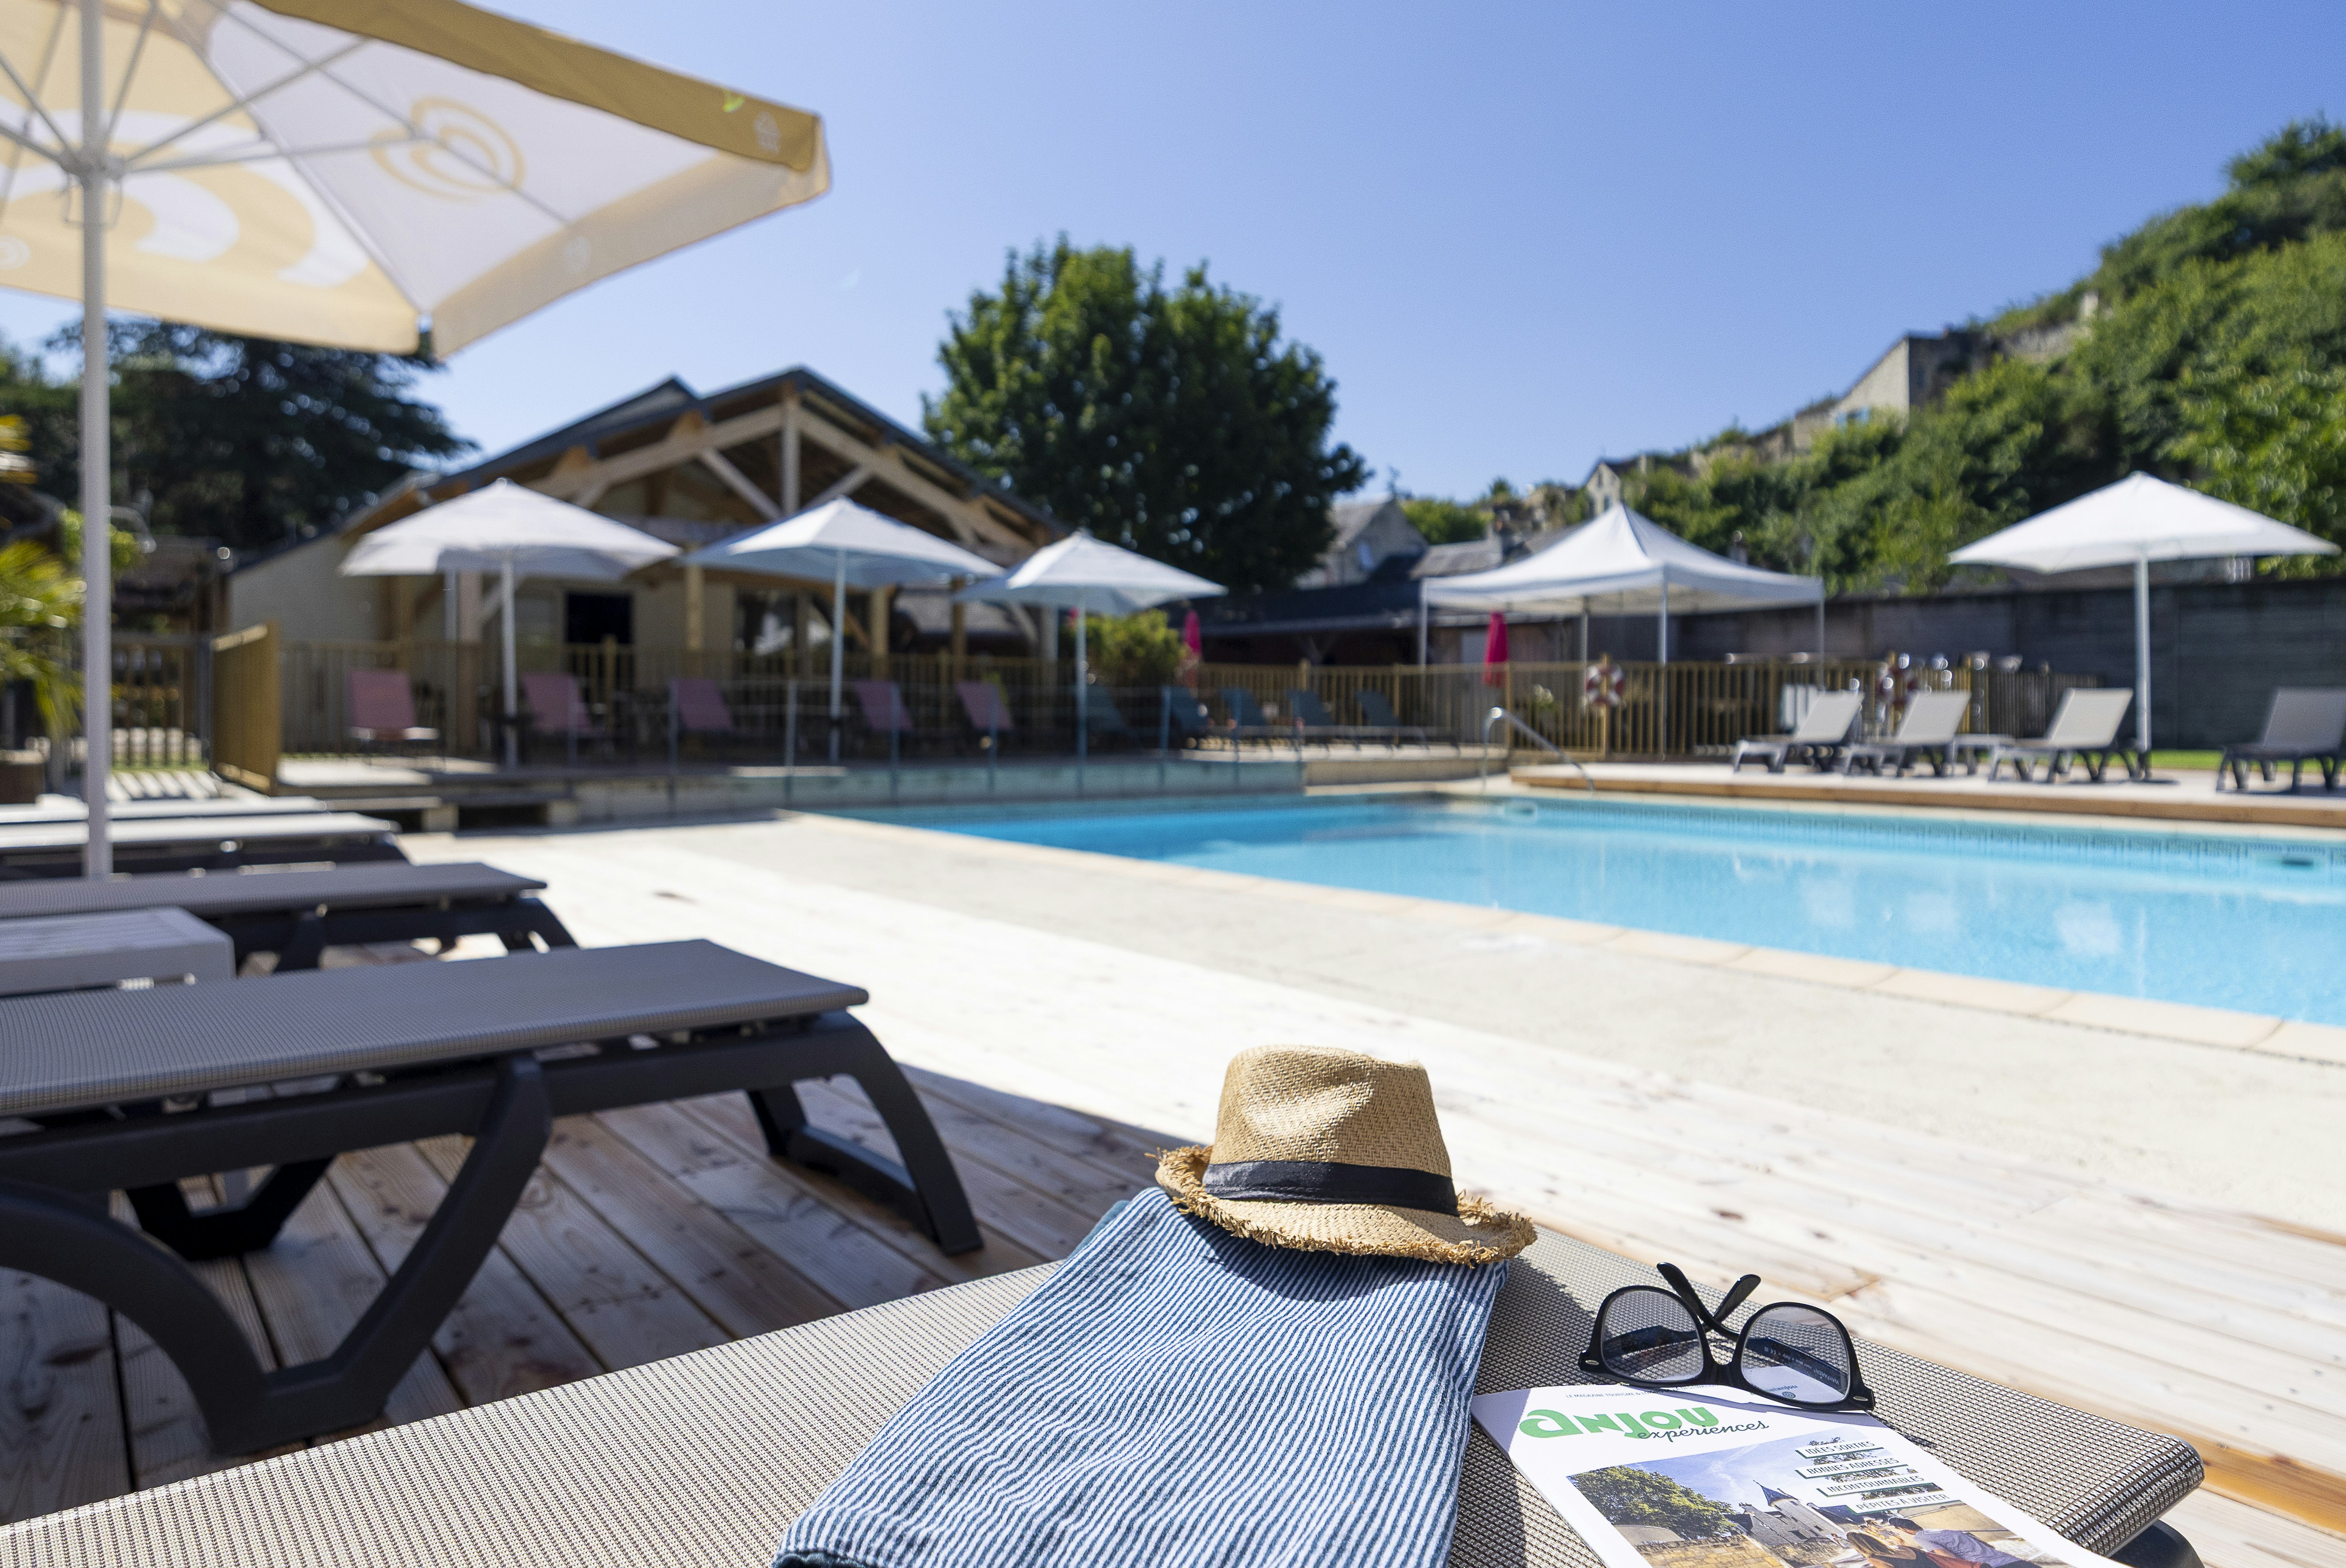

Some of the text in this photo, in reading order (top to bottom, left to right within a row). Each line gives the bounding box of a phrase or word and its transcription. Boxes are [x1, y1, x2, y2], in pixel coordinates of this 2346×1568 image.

[1805, 1441, 1875, 1454] IDÉES SORTIES
[1807, 1458, 1899, 1474] BONNES ADRESSES
[1827, 1476, 1924, 1493] INCONTOURNABLES
[1856, 1494, 1950, 1510] PÉPITES À VISITER
